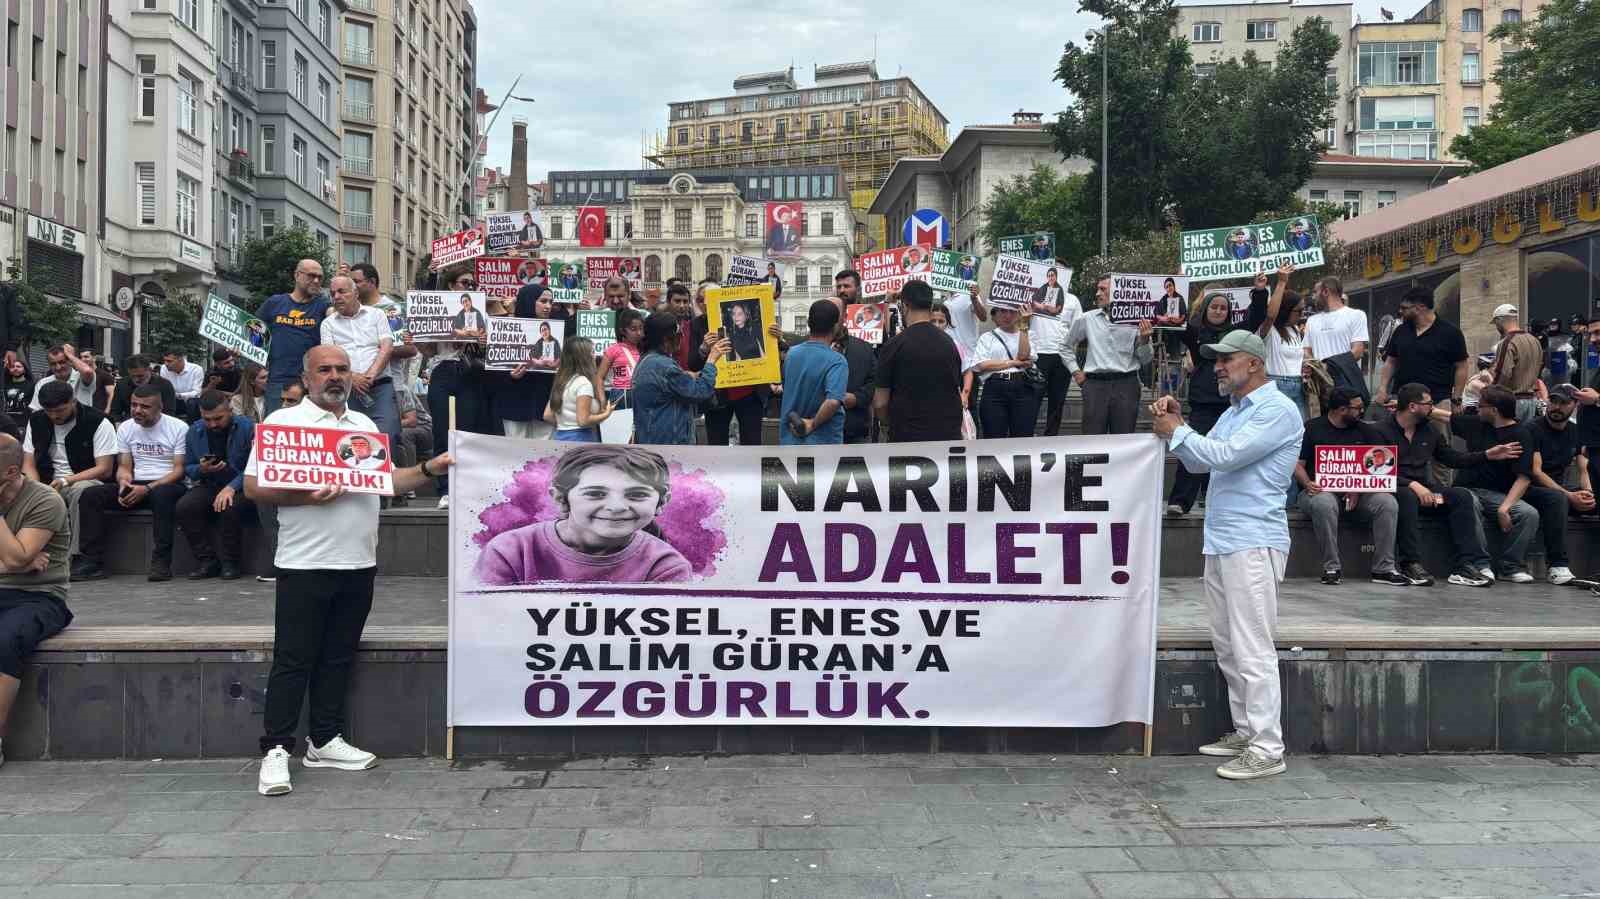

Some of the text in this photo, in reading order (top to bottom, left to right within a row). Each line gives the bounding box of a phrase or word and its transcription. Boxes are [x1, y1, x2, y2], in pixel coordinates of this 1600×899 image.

[488, 215, 512, 224] YÜKSEL
[1183, 233, 1215, 249] ENES
[1260, 226, 1273, 241] ES
[433, 236, 458, 250] SALİM
[1001, 239, 1024, 252] ENES
[1260, 239, 1286, 254] RAN'A
[439, 246, 481, 264] ZGÜRLÜK!
[863, 251, 895, 268] SALİM
[933, 250, 950, 264] NES
[1183, 246, 1225, 261] GÜRAN'A
[479, 260, 511, 273] SALİM
[589, 258, 614, 269] SALİM
[733, 255, 756, 268] YÜKSEL
[1000, 258, 1030, 274] YÜKSEL
[1259, 250, 1320, 274] ZGÜRLÜK!
[589, 268, 617, 279] GÜRAN'A
[863, 265, 901, 280] GÜRAN'A
[933, 265, 955, 276] RAN'A
[1184, 260, 1257, 279] ÖZGÜRLÜK!
[479, 272, 518, 285] GÜRAN'A
[931, 275, 970, 292] ZGÜRLÜK
[997, 269, 1032, 286] GÜRAN'A
[1114, 277, 1147, 289] YÜKSEL
[410, 293, 444, 305] YÜKSEL
[480, 285, 518, 298] ÖZGÜR
[552, 288, 581, 300] RLÜK!
[991, 281, 1035, 304] ÖZGÜRLÜK
[1113, 289, 1151, 300] GÜRAN'A
[209, 299, 238, 321] ENES
[410, 304, 449, 316] GÜRAN'A
[1111, 302, 1156, 319] ÖZGÜRLÜK
[207, 310, 243, 336] GÜRAN'A
[408, 316, 453, 333] ÖZGÜRLÜK
[491, 320, 522, 333] YÜKSEL
[580, 313, 608, 326] ENES
[490, 332, 527, 344] GÜRAN'A
[580, 326, 616, 338] GÜRAN'A
[204, 321, 265, 362] ÖZGÜRLÜK!
[488, 344, 531, 361] ÖZGÜRLÜK
[262, 429, 324, 448] SALİM
[263, 446, 336, 465] GÜRAN'A
[1319, 448, 1356, 462] SALİM
[1319, 461, 1362, 474] GÜRAN'A
[263, 465, 385, 489] ÖZGÜRLÜK!
[761, 446, 1109, 513] NARİN'E
[1320, 475, 1392, 489] ÖZGÜRLÜK!
[758, 523, 1130, 585] ADALET!
[527, 601, 980, 640] YÜKSEL, ENES VE
[526, 637, 949, 673] SALİM GÜRAN'A
[525, 673, 930, 720] ÖZGÜRLÜK.
